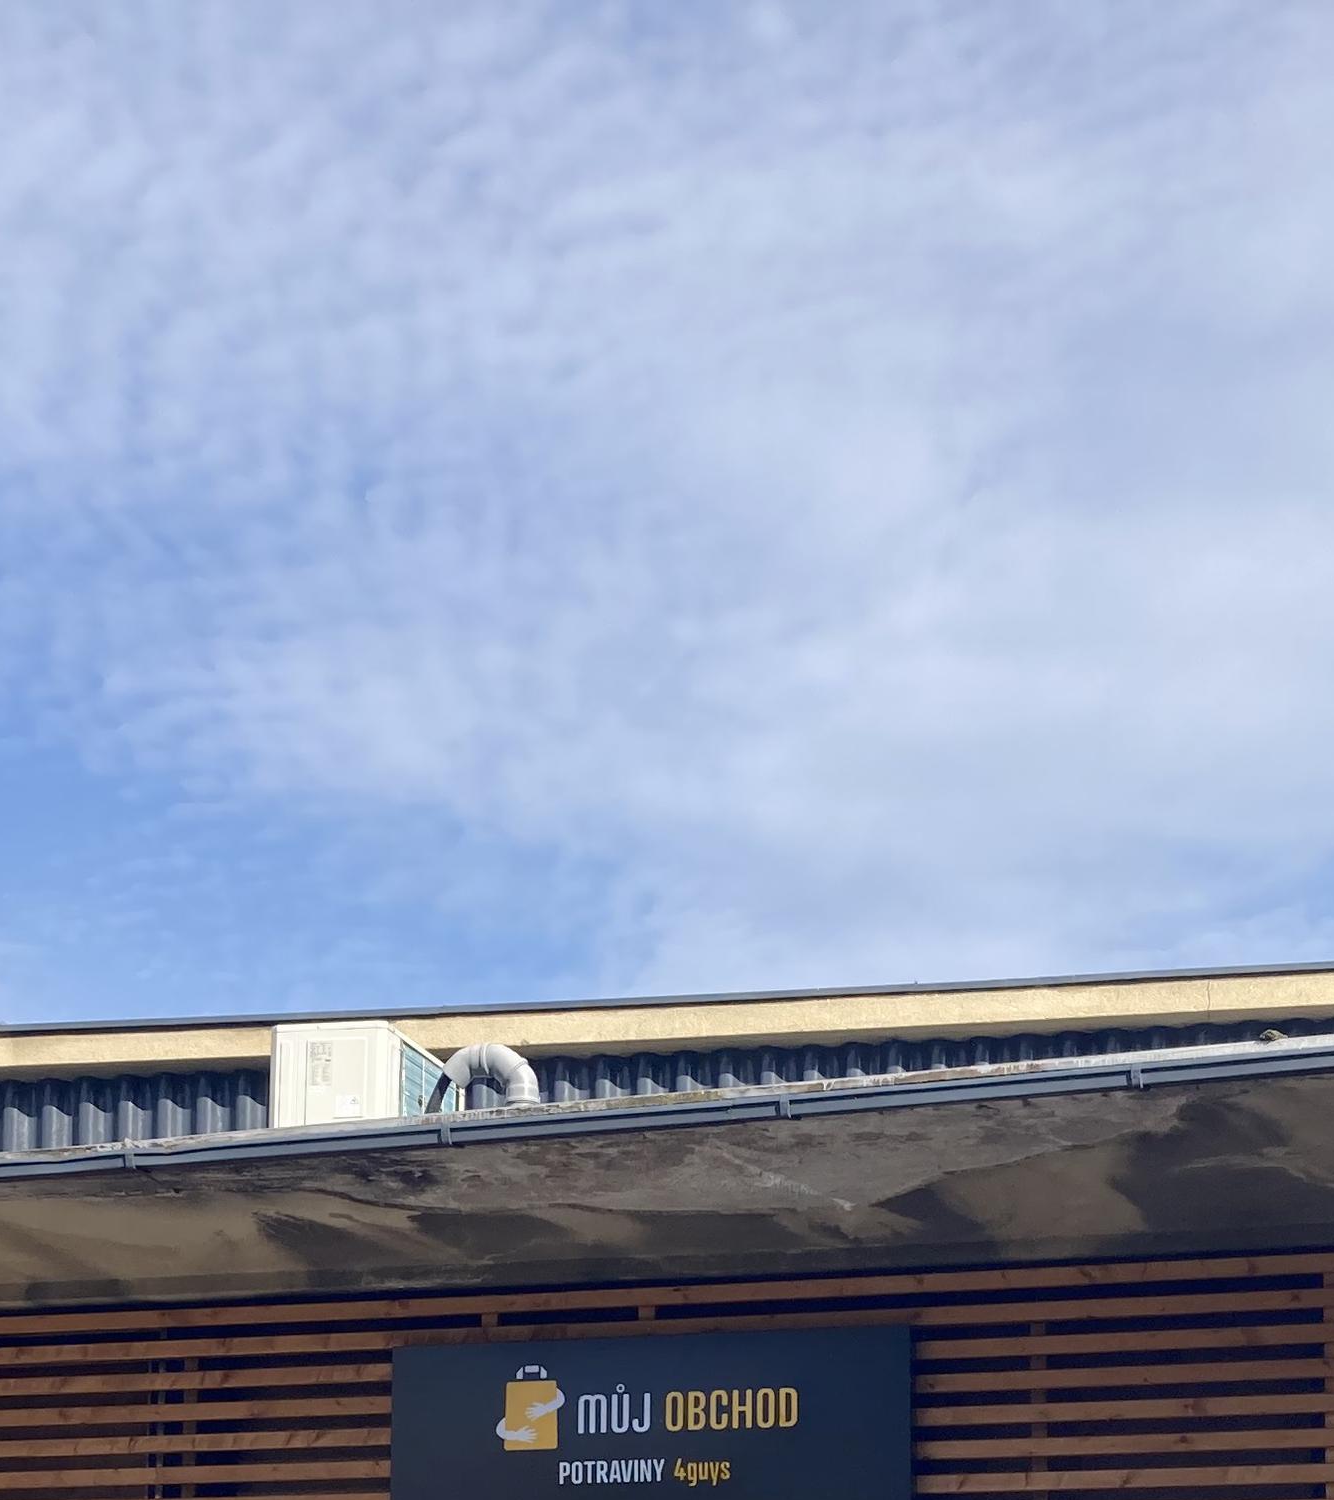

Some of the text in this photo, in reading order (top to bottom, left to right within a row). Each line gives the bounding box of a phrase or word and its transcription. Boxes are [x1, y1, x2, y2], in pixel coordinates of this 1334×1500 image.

[577, 1383, 799, 1434] MŮJ OBCHOD
[558, 1457, 732, 1487] POTRAVINY 4guys
